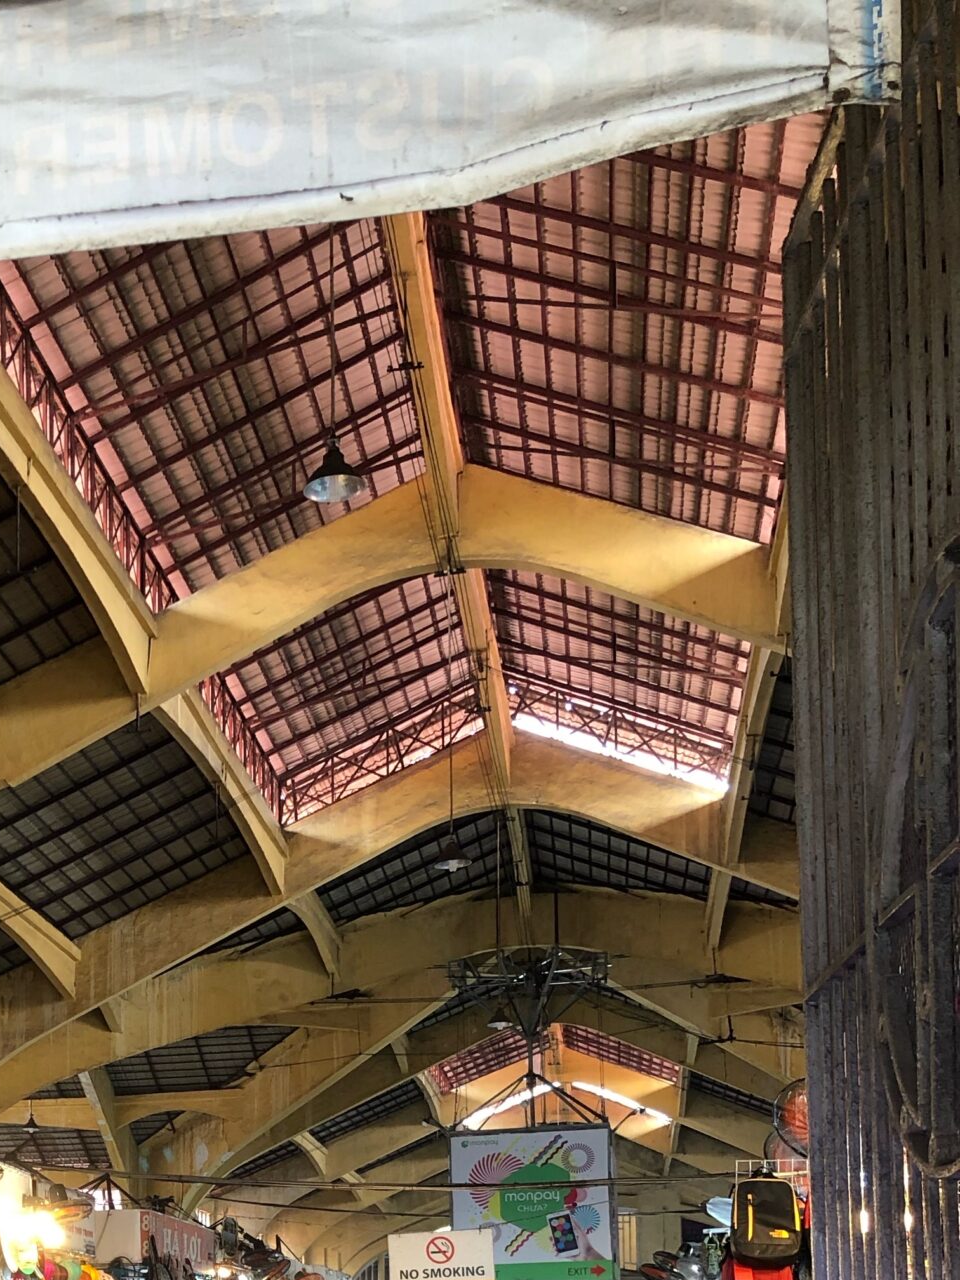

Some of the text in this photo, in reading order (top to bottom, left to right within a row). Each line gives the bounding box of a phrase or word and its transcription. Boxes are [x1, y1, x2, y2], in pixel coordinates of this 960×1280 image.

[504, 1190, 560, 1203] monpay
[400, 1269, 419, 1280] NO
[423, 1266, 485, 1279] SMOKING
[567, 1267, 589, 1277] EXIT
